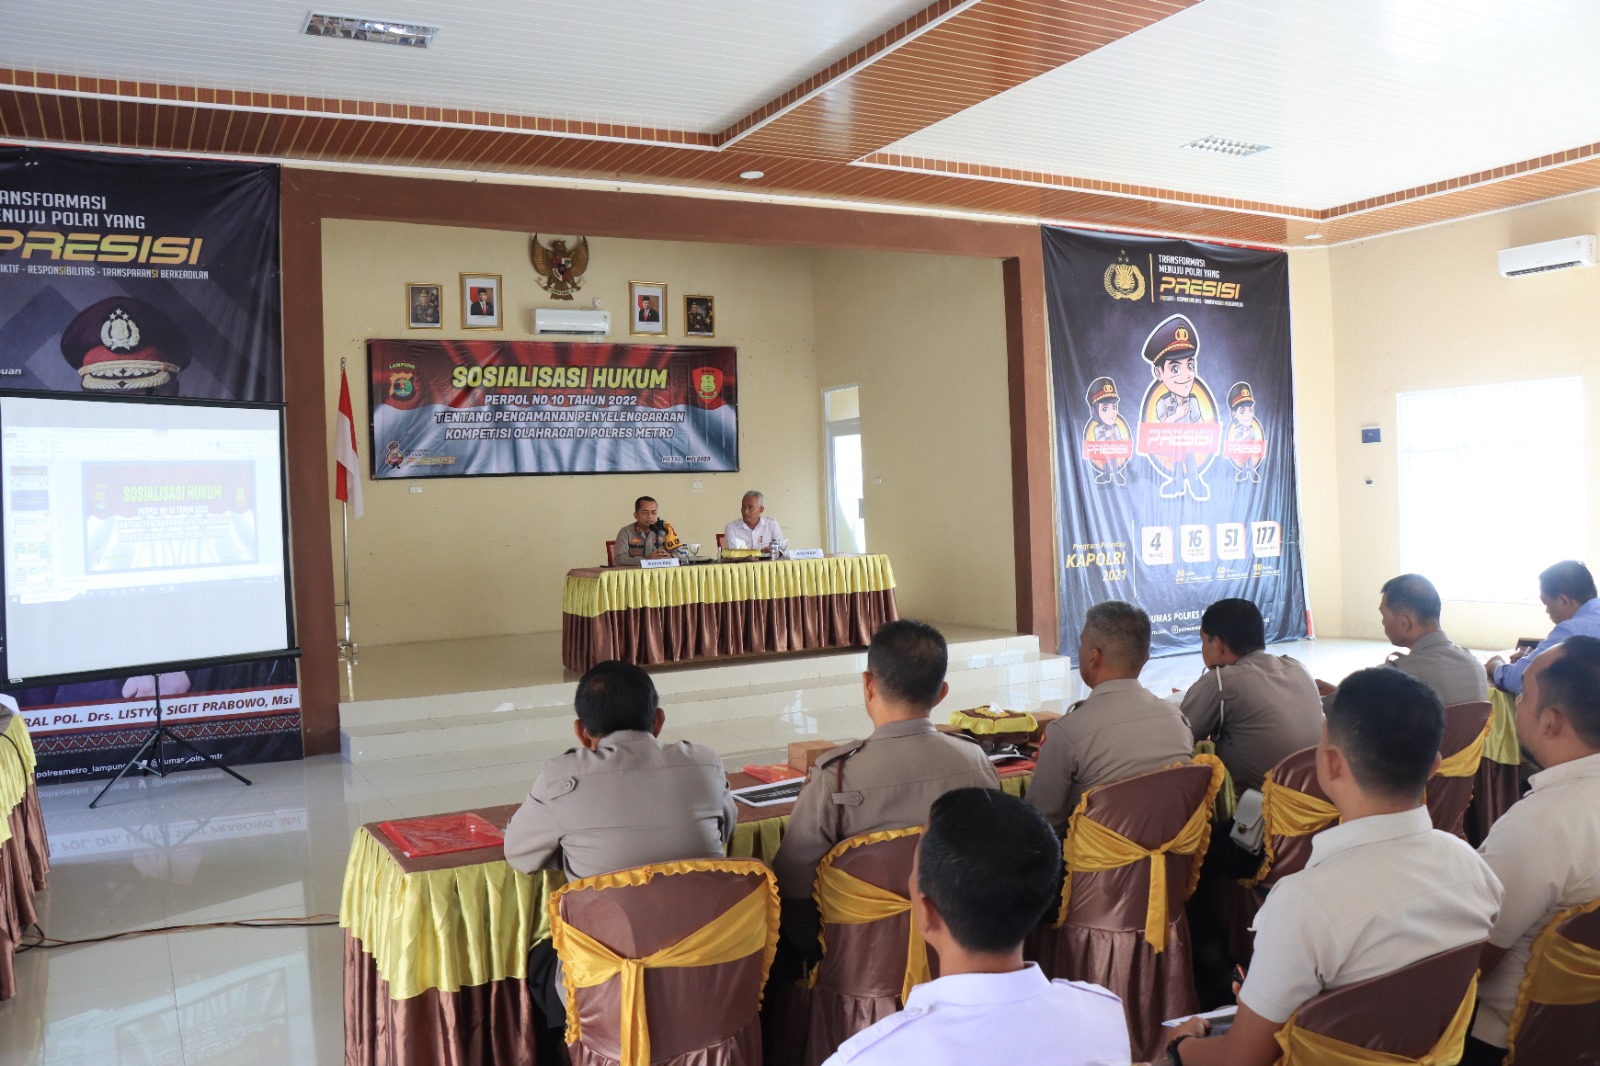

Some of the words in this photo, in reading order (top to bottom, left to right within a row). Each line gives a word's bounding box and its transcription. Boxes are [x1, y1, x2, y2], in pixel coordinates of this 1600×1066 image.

[0, 208, 46, 224] NUJU
[51, 210, 99, 227] POLRI
[103, 213, 146, 229] YANG
[1158, 254, 1206, 268] TRANSFORMASI
[27, 264, 96, 276] RESPONSIBILITAS
[102, 267, 159, 279] TRANSPARANSI
[160, 269, 209, 280] BERKEADILAN
[1159, 264, 1184, 275] MENUJU
[1185, 266, 1203, 277] POLRI
[1204, 269, 1220, 279] YANG
[1160, 276, 1241, 300] PRESISI
[0, 368, 22, 376] uan
[388, 362, 416, 370] LAMPUNG
[452, 365, 589, 389] SOSIALISASI
[591, 367, 669, 390] HUKUM
[484, 394, 530, 406] PERPOL
[532, 394, 549, 405] NO
[551, 394, 566, 406] 10
[567, 394, 607, 406] TAHUN
[608, 395, 638, 406] 2022
[434, 411, 493, 423] TENTANG
[494, 411, 575, 423] PENGAMANAN
[576, 411, 686, 423] PENYELENGGARAAN
[445, 427, 512, 440] KOMPETISI
[513, 427, 575, 440] OLAHRAGA
[576, 427, 590, 439] DI
[591, 427, 633, 439] POLRES
[634, 427, 676, 439] METRO
[1147, 429, 1214, 447] PRESISI
[1087, 443, 1128, 454] PRESISI
[123, 485, 185, 502] SOSIALISASI
[187, 484, 223, 501] HUKUM
[1150, 532, 1162, 551] 4
[1188, 529, 1203, 548] 16
[1224, 528, 1239, 547] 51
[1256, 526, 1276, 545] 177
[1065, 550, 1127, 568] KAPOLRI
[1102, 568, 1127, 581] 2021
[1173, 610, 1200, 621] POLRES
[53, 713, 84, 725] POL.
[87, 712, 114, 722] Drs.
[118, 706, 163, 720] LISTYO
[166, 703, 200, 716] SIGIT
[202, 697, 268, 712] PRABOWO,
[272, 694, 294, 706] Msi
